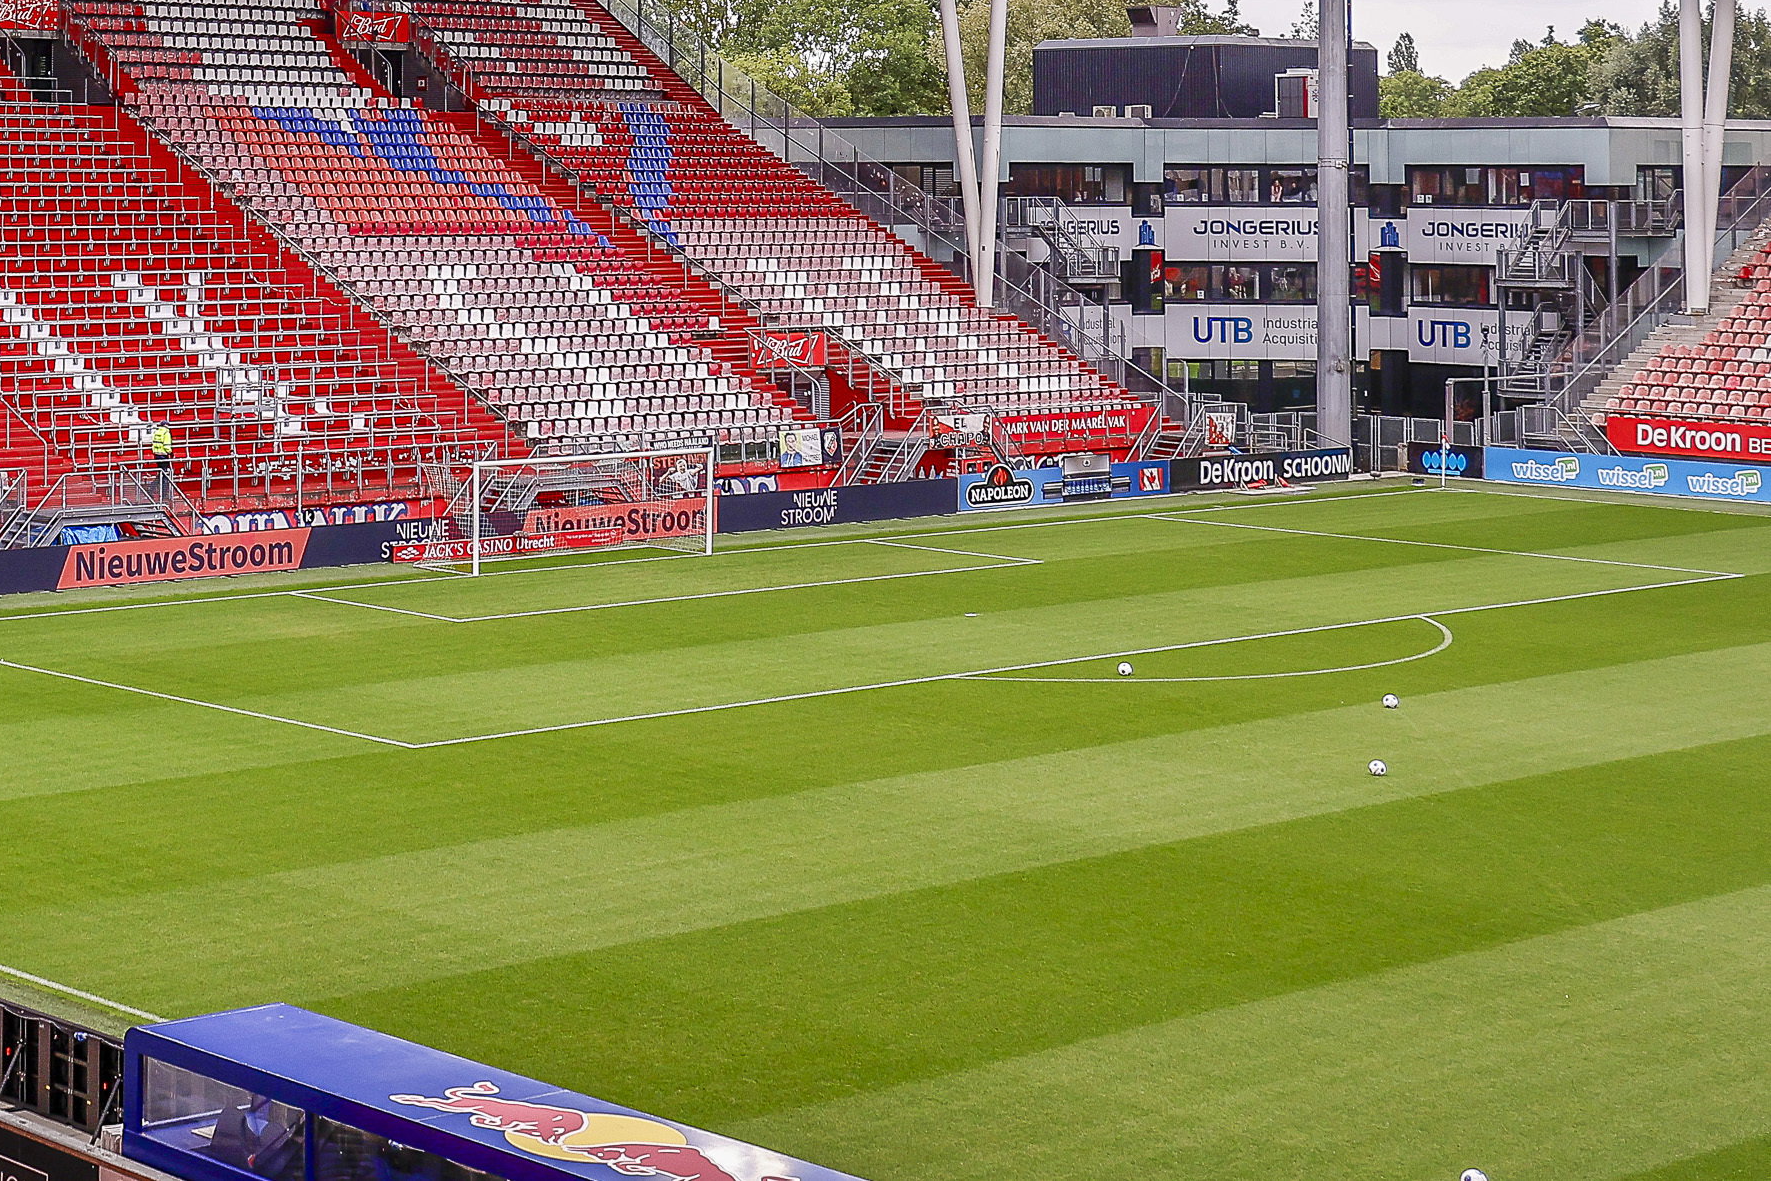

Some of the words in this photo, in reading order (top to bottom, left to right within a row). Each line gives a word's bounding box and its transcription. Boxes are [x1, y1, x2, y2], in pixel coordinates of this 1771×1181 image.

[354, 18, 388, 34] Bud
[1213, 239, 1269, 249] INVEST
[1280, 240, 1310, 249] B.V.
[1439, 242, 1490, 252] INVEST
[1193, 317, 1253, 344] UTB
[1262, 318, 1318, 330] Industria
[1418, 319, 1471, 349] UTB
[771, 335, 805, 359] Bud
[953, 418, 967, 430] EL
[1002, 422, 1029, 435] MARK
[1029, 420, 1050, 433] VAN
[1052, 420, 1069, 432] DER
[1108, 415, 1126, 428] VAK
[939, 432, 984, 446] CHAPO
[1636, 423, 1741, 452] DeKroon
[1199, 459, 1274, 485] DeKroon
[793, 490, 838, 509] NIEUWE
[781, 507, 836, 525] STROOM
[395, 519, 450, 540] NIEUWE
[422, 542, 465, 559] JACK'S
[515, 534, 555, 552] Utrecht
[75, 537, 295, 582] NieuweStroom
